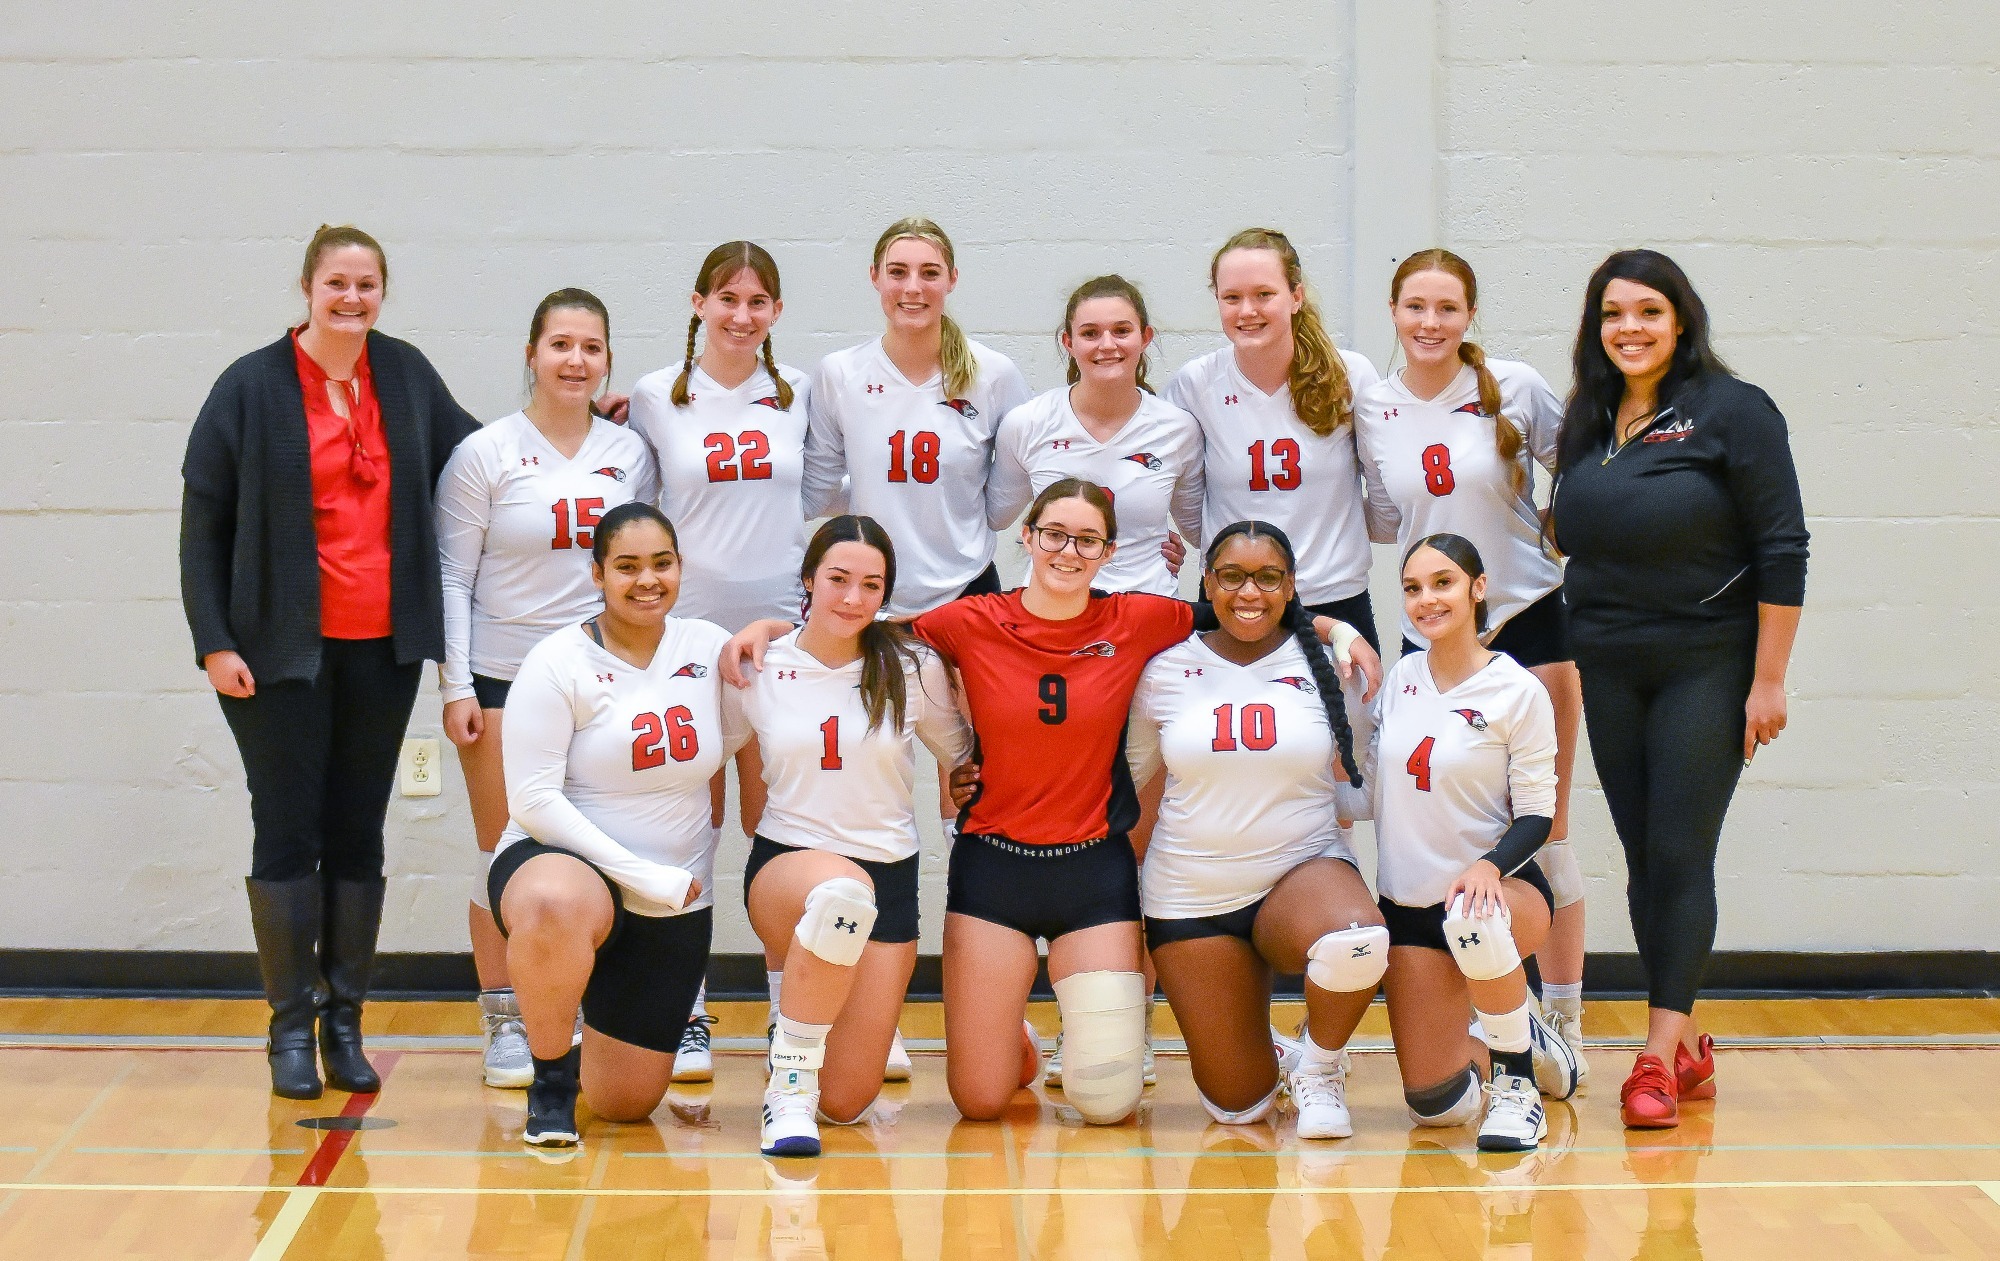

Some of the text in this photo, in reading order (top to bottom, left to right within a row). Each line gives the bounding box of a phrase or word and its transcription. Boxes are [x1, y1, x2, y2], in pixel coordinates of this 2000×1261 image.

[704, 430, 772, 482] 22
[888, 430, 940, 484] 18
[1248, 438, 1302, 491] 13
[1422, 443, 1455, 497] 8
[552, 497, 604, 550] 15
[1039, 674, 1067, 725] 9
[632, 705, 699, 771] 26
[820, 716, 842, 770] 1
[1212, 703, 1277, 752] 10
[1407, 736, 1436, 792] 4
[1039, 842, 1087, 858] ARMOUR
